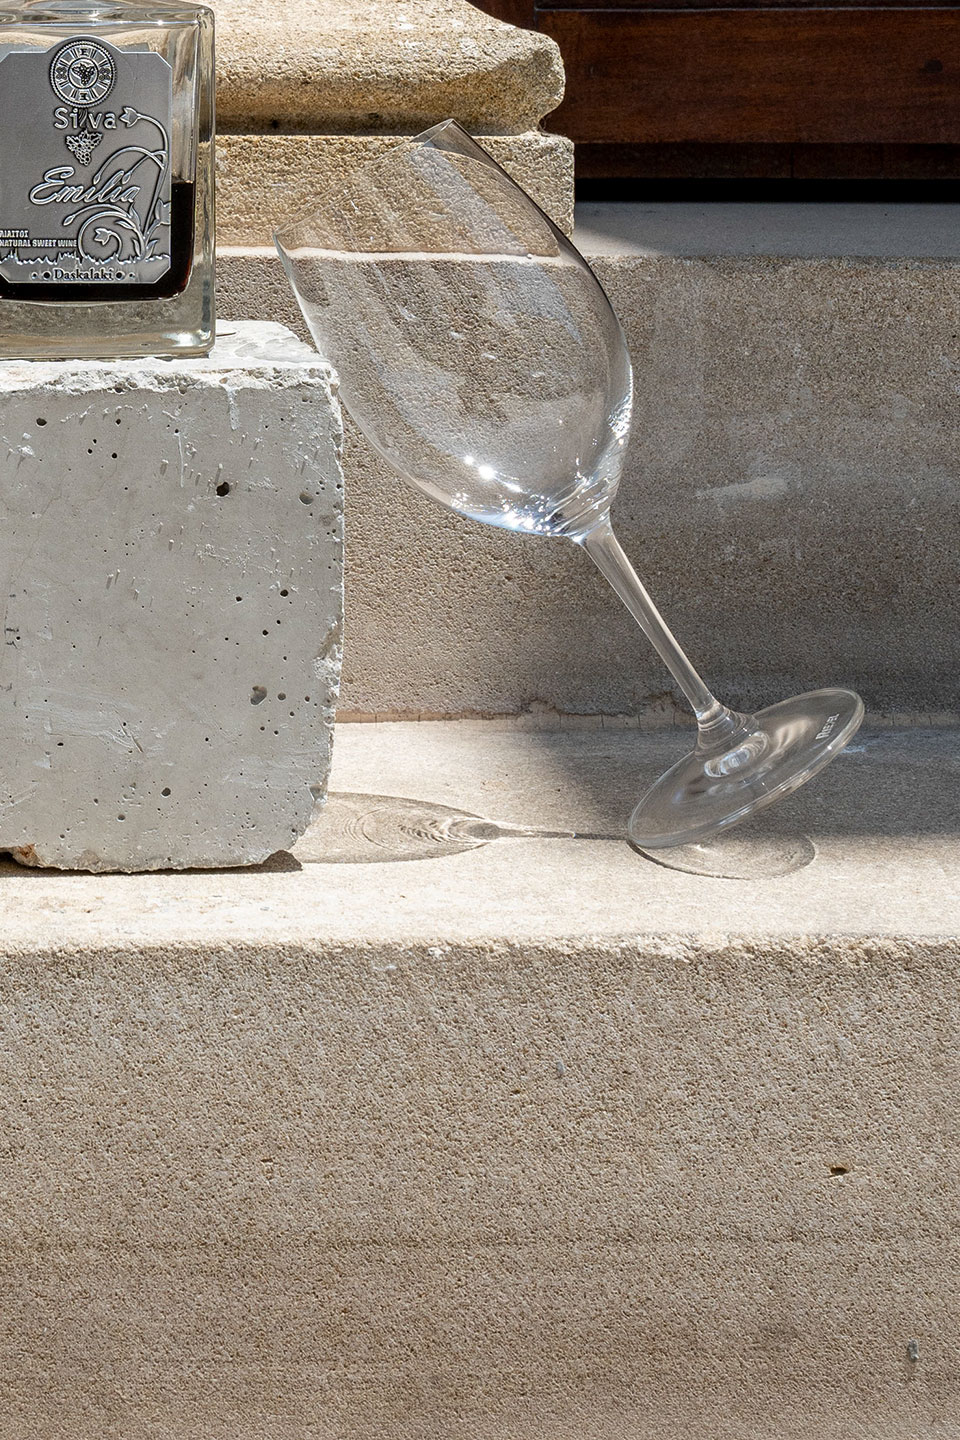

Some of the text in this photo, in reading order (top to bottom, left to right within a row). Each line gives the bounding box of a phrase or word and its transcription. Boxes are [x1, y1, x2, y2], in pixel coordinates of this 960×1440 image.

[29, 166, 141, 205] Emilia
[32, 239, 57, 248] SWEET
[58, 239, 78, 248] WINE
[53, 268, 114, 281] Daskalaki
